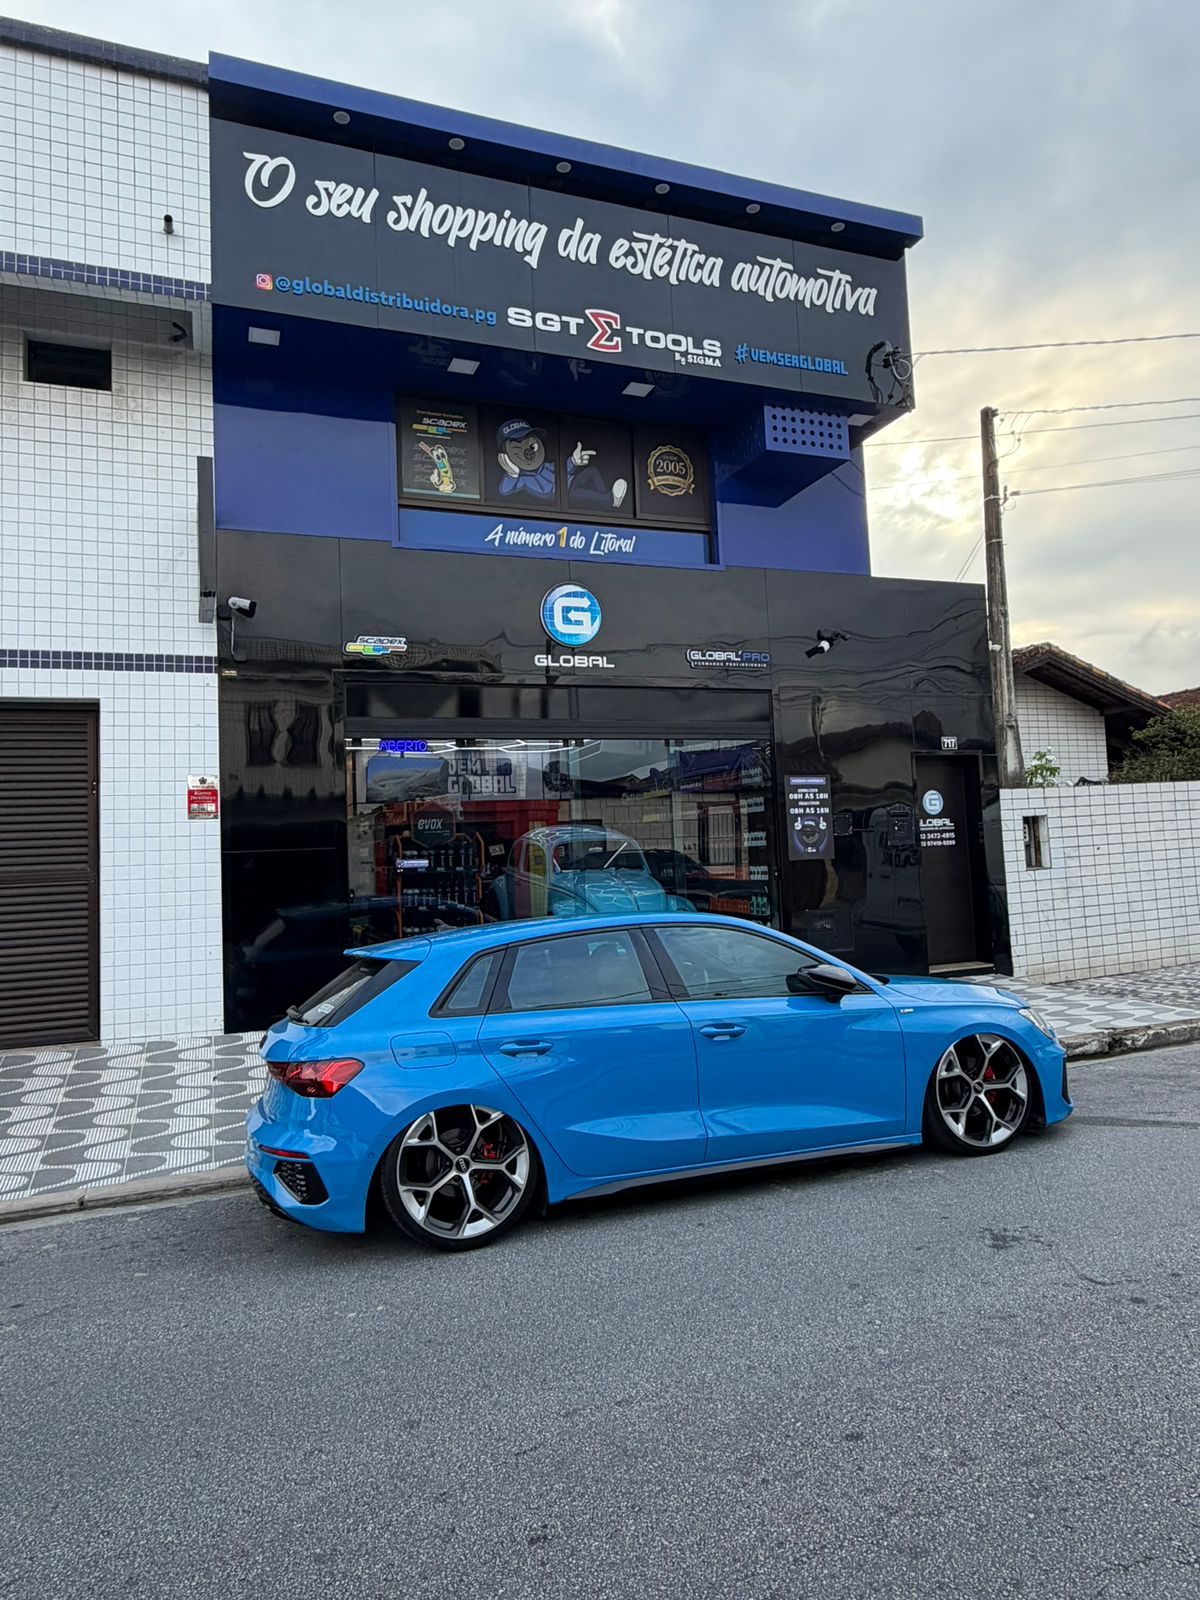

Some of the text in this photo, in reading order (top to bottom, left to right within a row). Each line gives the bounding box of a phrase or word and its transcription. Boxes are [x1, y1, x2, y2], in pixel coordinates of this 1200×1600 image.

[243, 152, 879, 316] O seu shopping da estética automotiva
[275, 275, 497, 326] @globaldistribuidora.pg
[507, 306, 584, 335] SGT
[626, 326, 722, 358] TOOLS
[674, 352, 722, 368] By SIGMA
[422, 417, 467, 429] scapex
[656, 459, 686, 475] 2005
[485, 523, 636, 555] A número 1 do Litoral
[359, 637, 405, 646] scapex
[534, 654, 615, 669] GLOBAL
[690, 650, 770, 662] GLOBAL PRO
[379, 739, 428, 752] ABERTO
[943, 738, 955, 748] 717
[417, 818, 443, 830] evox
